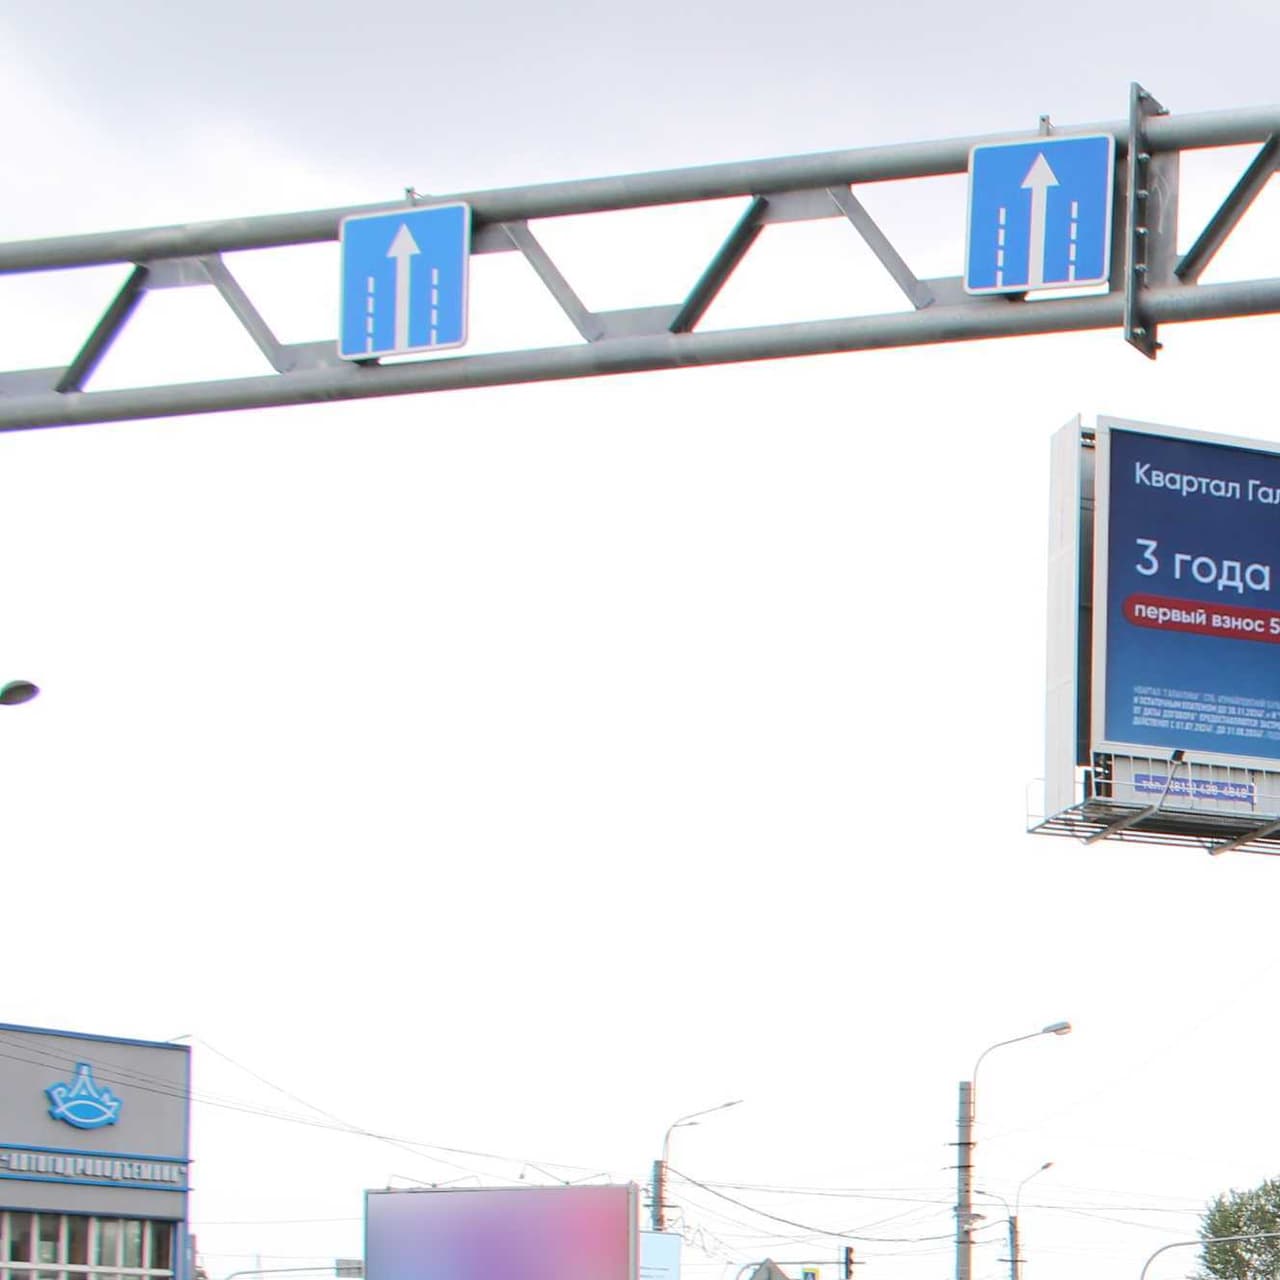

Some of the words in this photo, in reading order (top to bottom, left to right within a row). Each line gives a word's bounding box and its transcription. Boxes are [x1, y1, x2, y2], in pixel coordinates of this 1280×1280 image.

[1134, 461, 1241, 499] Квартал
[1135, 538, 1159, 576] 3
[1174, 553, 1271, 594] года
[1134, 604, 1207, 625] первый
[1212, 615, 1265, 633] взнос
